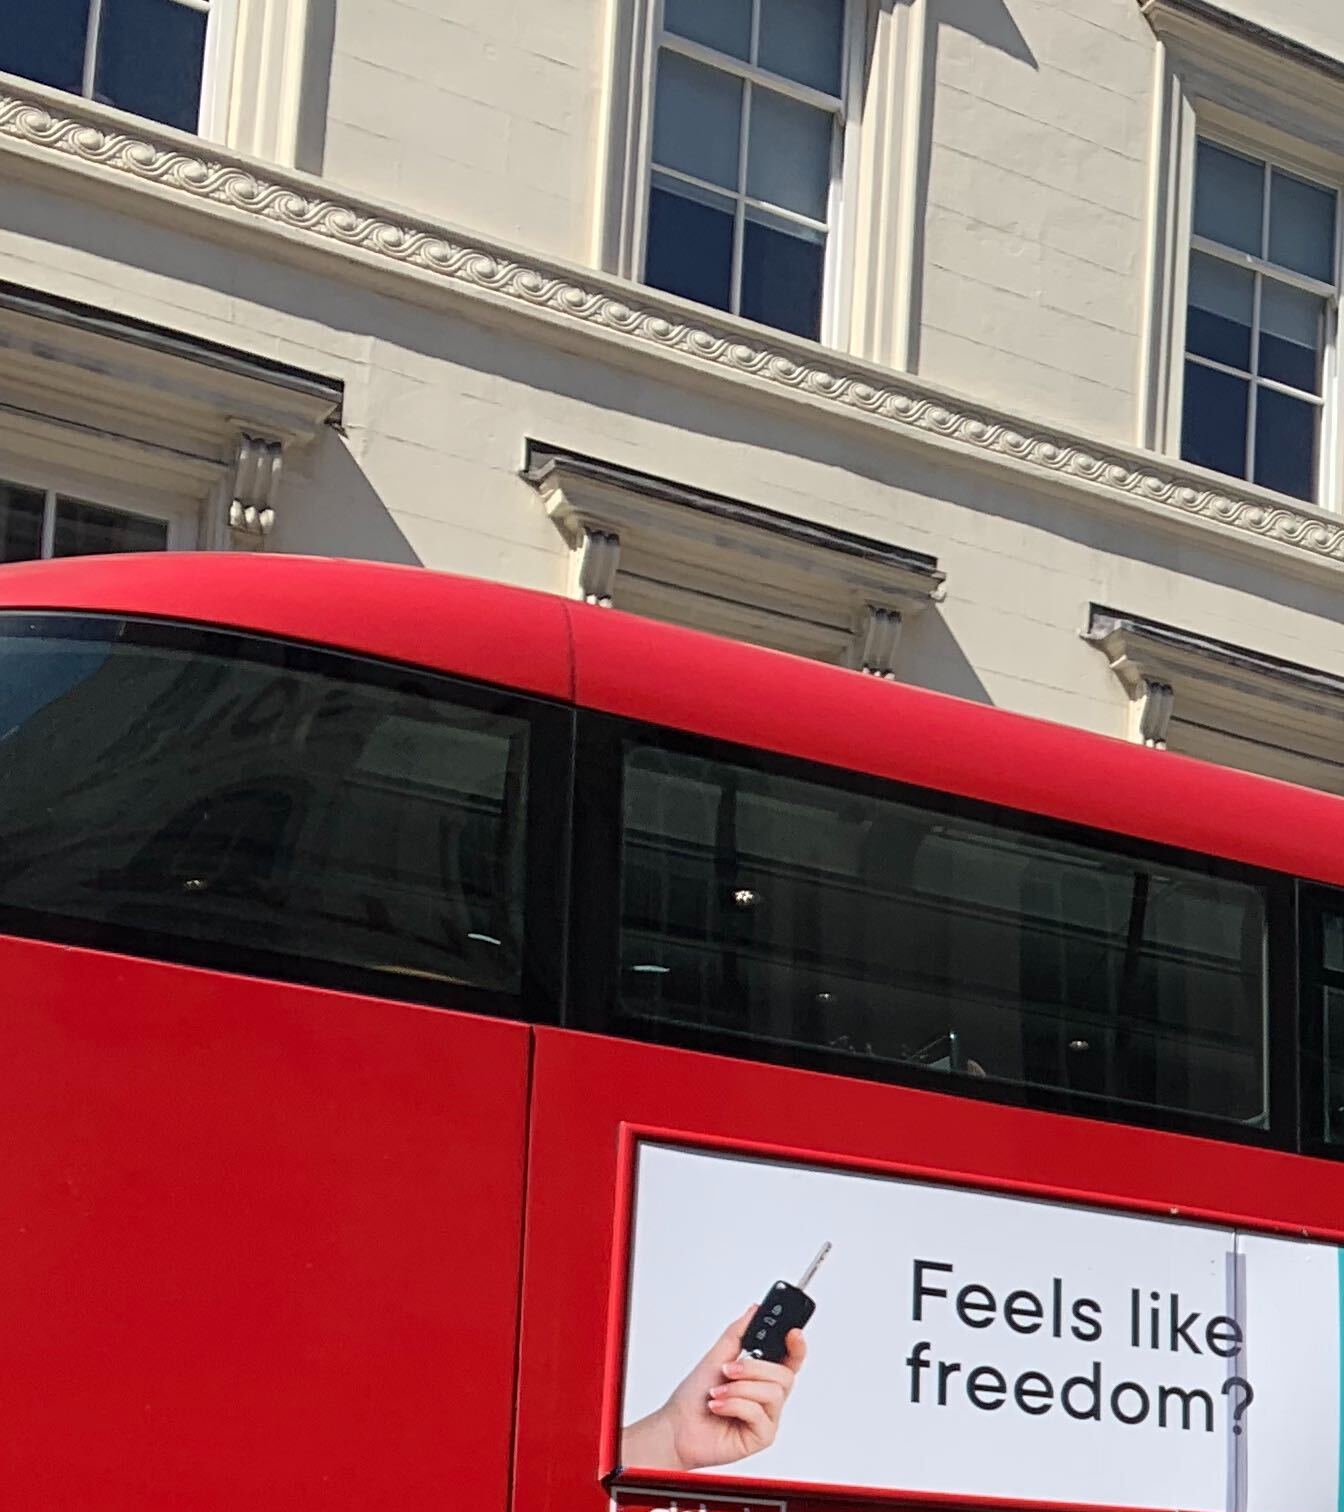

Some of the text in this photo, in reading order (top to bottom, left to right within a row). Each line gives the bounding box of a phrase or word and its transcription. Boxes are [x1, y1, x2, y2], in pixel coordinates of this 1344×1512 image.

[910, 1258, 1244, 1358] Feels like
[907, 1341, 1255, 1436] freedom?
